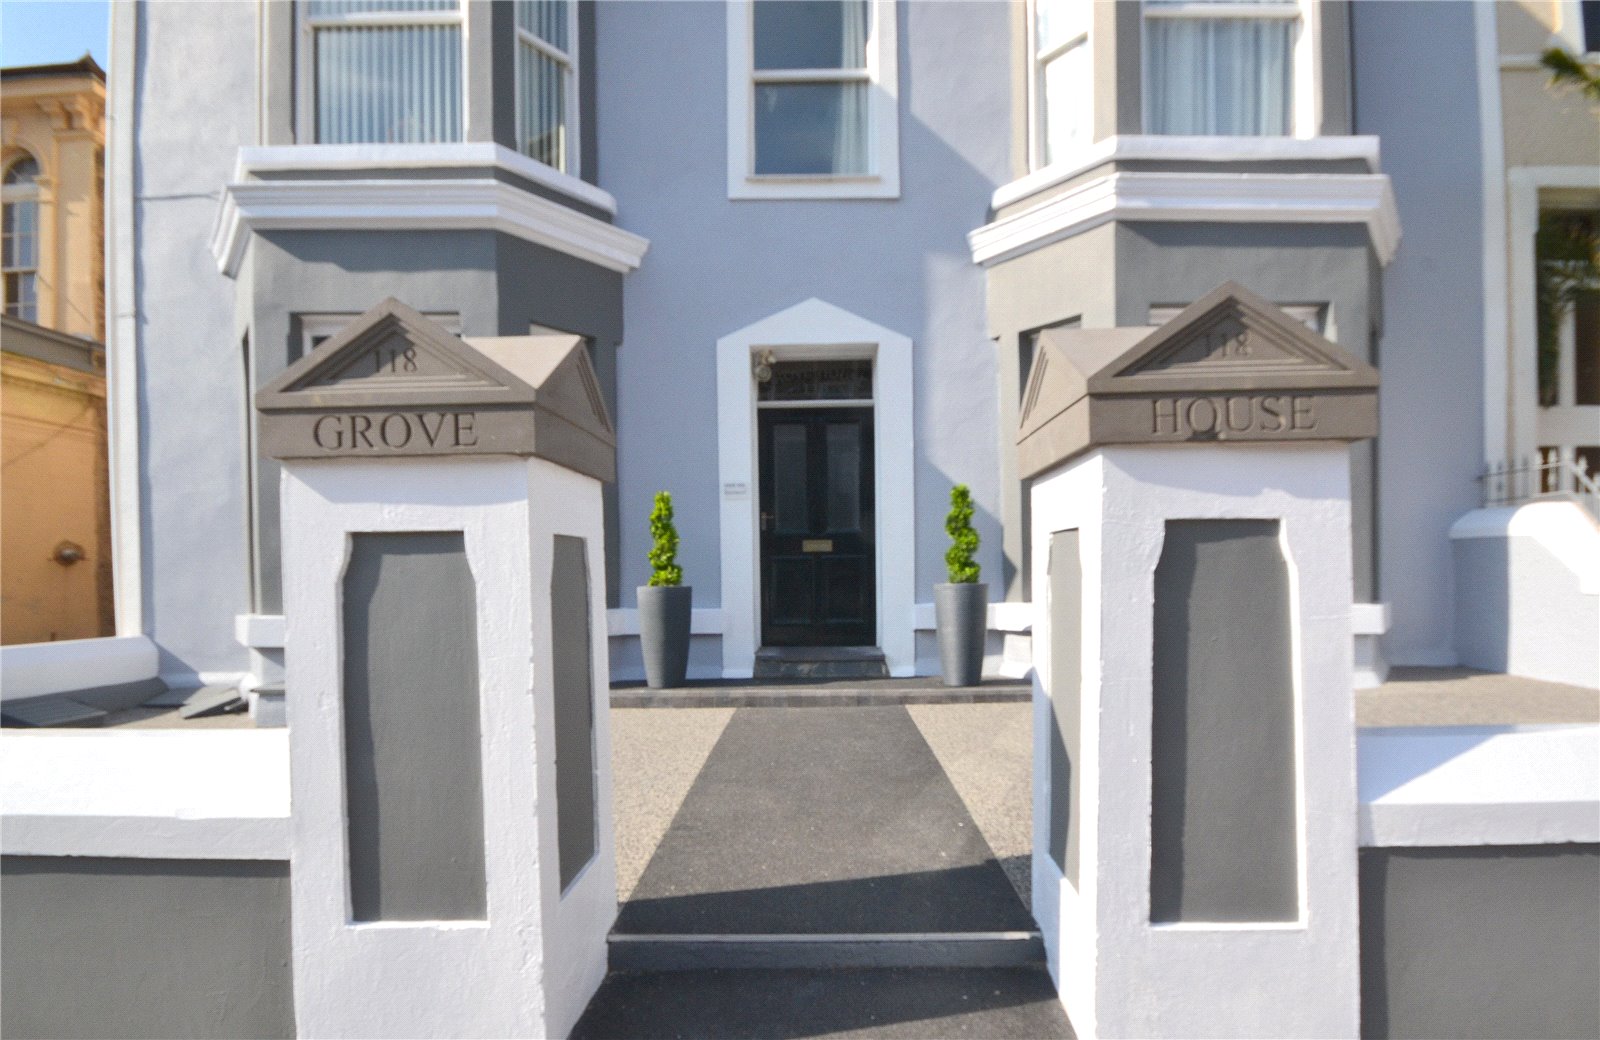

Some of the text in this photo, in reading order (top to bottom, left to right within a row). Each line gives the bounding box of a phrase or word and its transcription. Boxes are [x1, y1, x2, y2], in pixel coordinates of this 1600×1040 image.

[373, 347, 418, 373] 118
[1204, 332, 1249, 357] 118
[312, 411, 480, 449] GROVE
[1151, 395, 1319, 435] HOUSE
